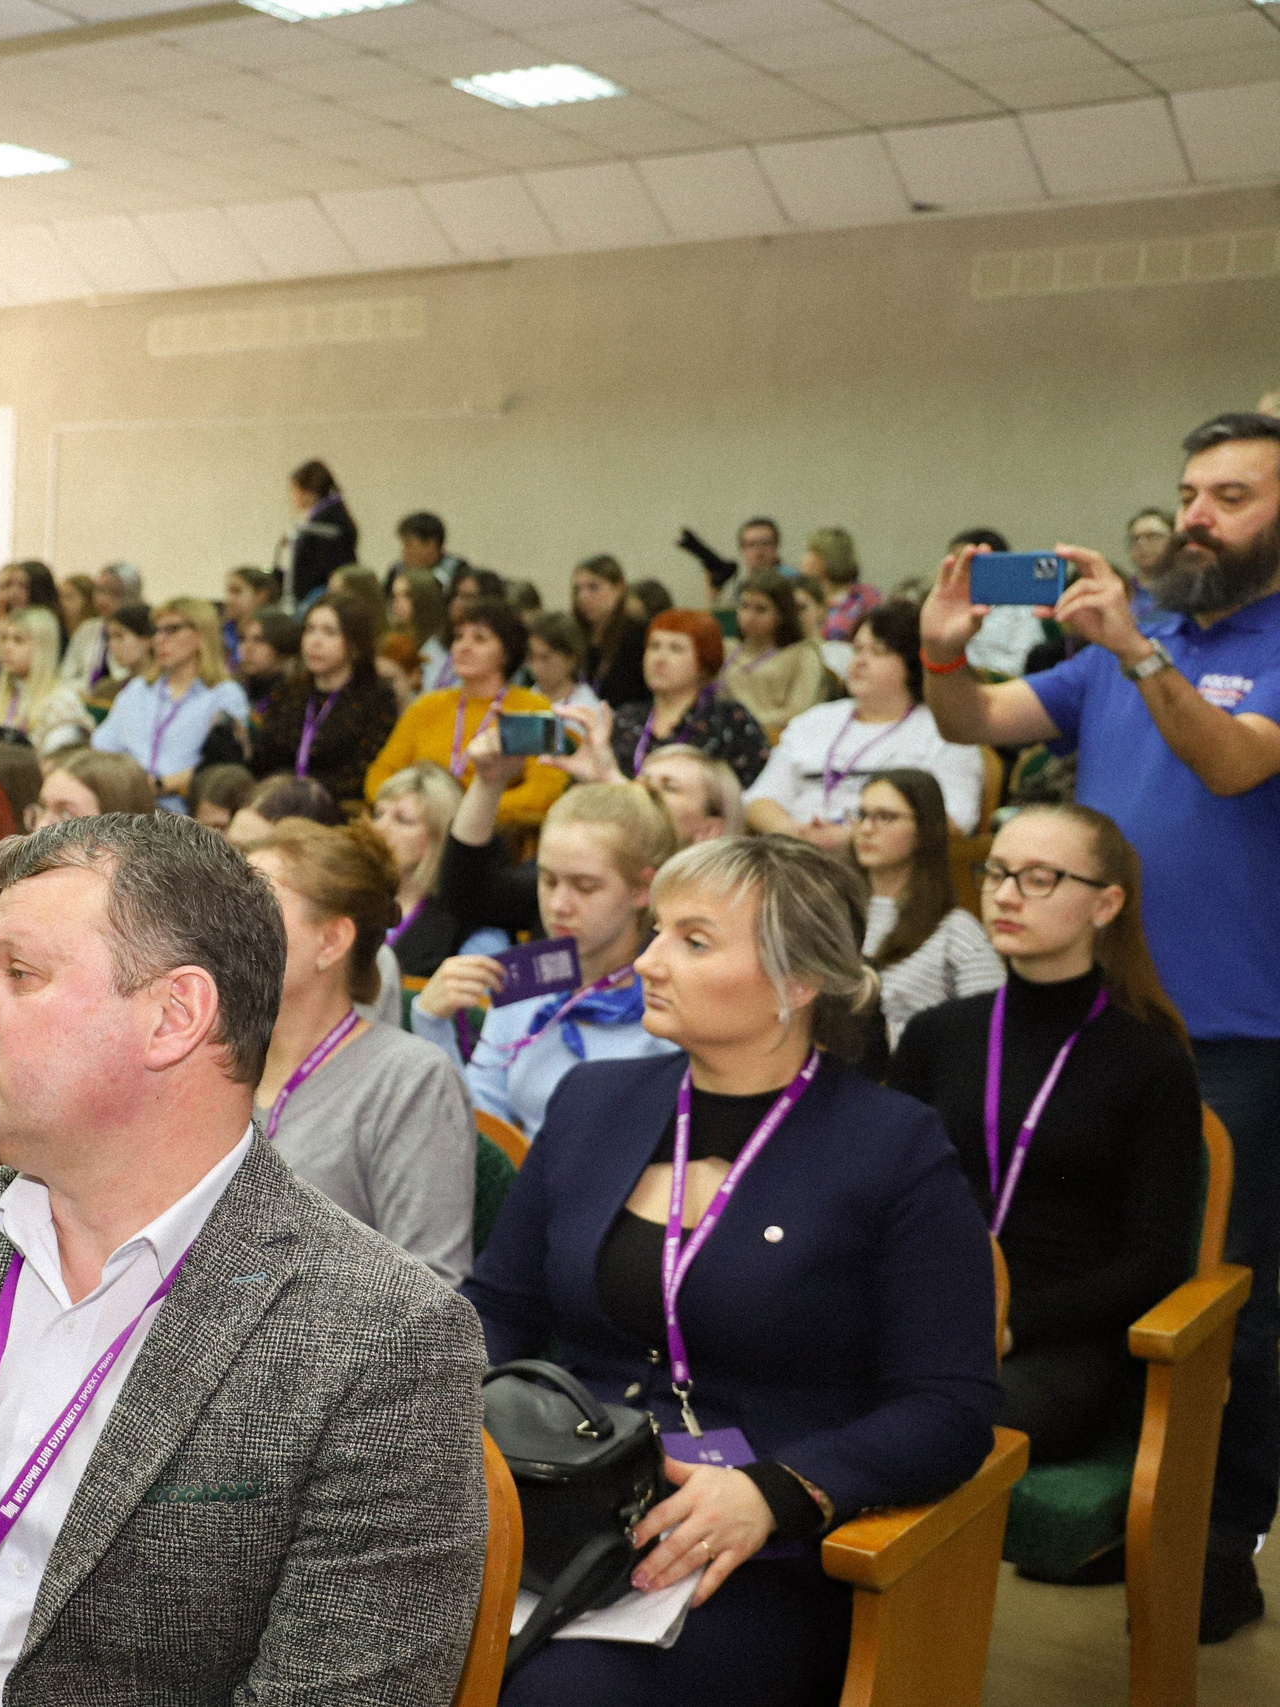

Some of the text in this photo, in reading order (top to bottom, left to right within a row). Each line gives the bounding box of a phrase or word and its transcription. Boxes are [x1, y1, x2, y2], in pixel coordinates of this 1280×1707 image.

[13, 1352, 114, 1503] ИСТОРИЯ ДЛЯ БУДУЩЕГО. ПРОЕКТ РВИО
